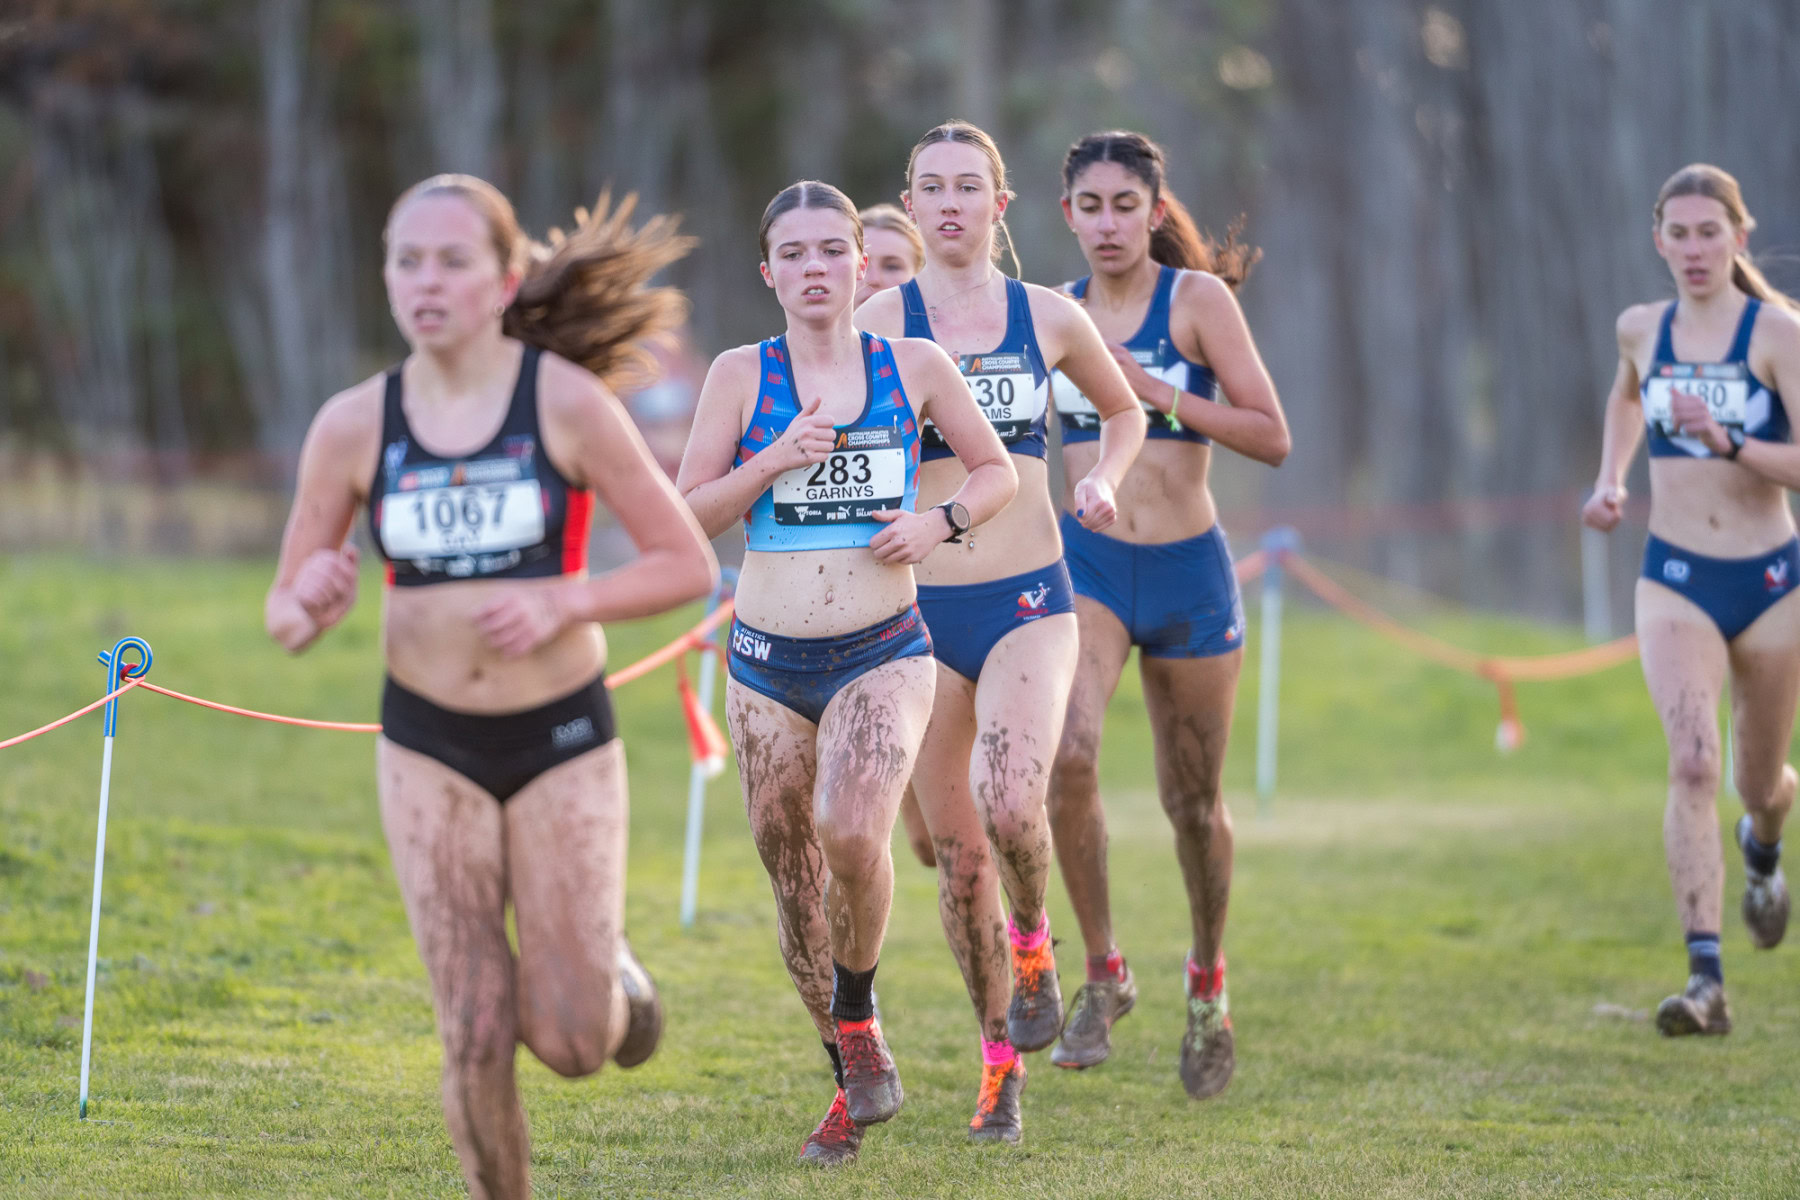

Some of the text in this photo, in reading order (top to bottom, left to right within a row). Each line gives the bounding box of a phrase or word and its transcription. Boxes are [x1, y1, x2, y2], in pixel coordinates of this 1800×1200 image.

[968, 377, 1015, 407] 30
[982, 407, 1012, 420] AMS
[848, 438, 890, 446] CHAMPIONSHIPS
[807, 454, 872, 487] 283
[806, 485, 874, 500] GARNYS
[413, 486, 506, 533] 1067
[733, 629, 772, 661] NSW
[741, 627, 767, 641] ATHLETICS
